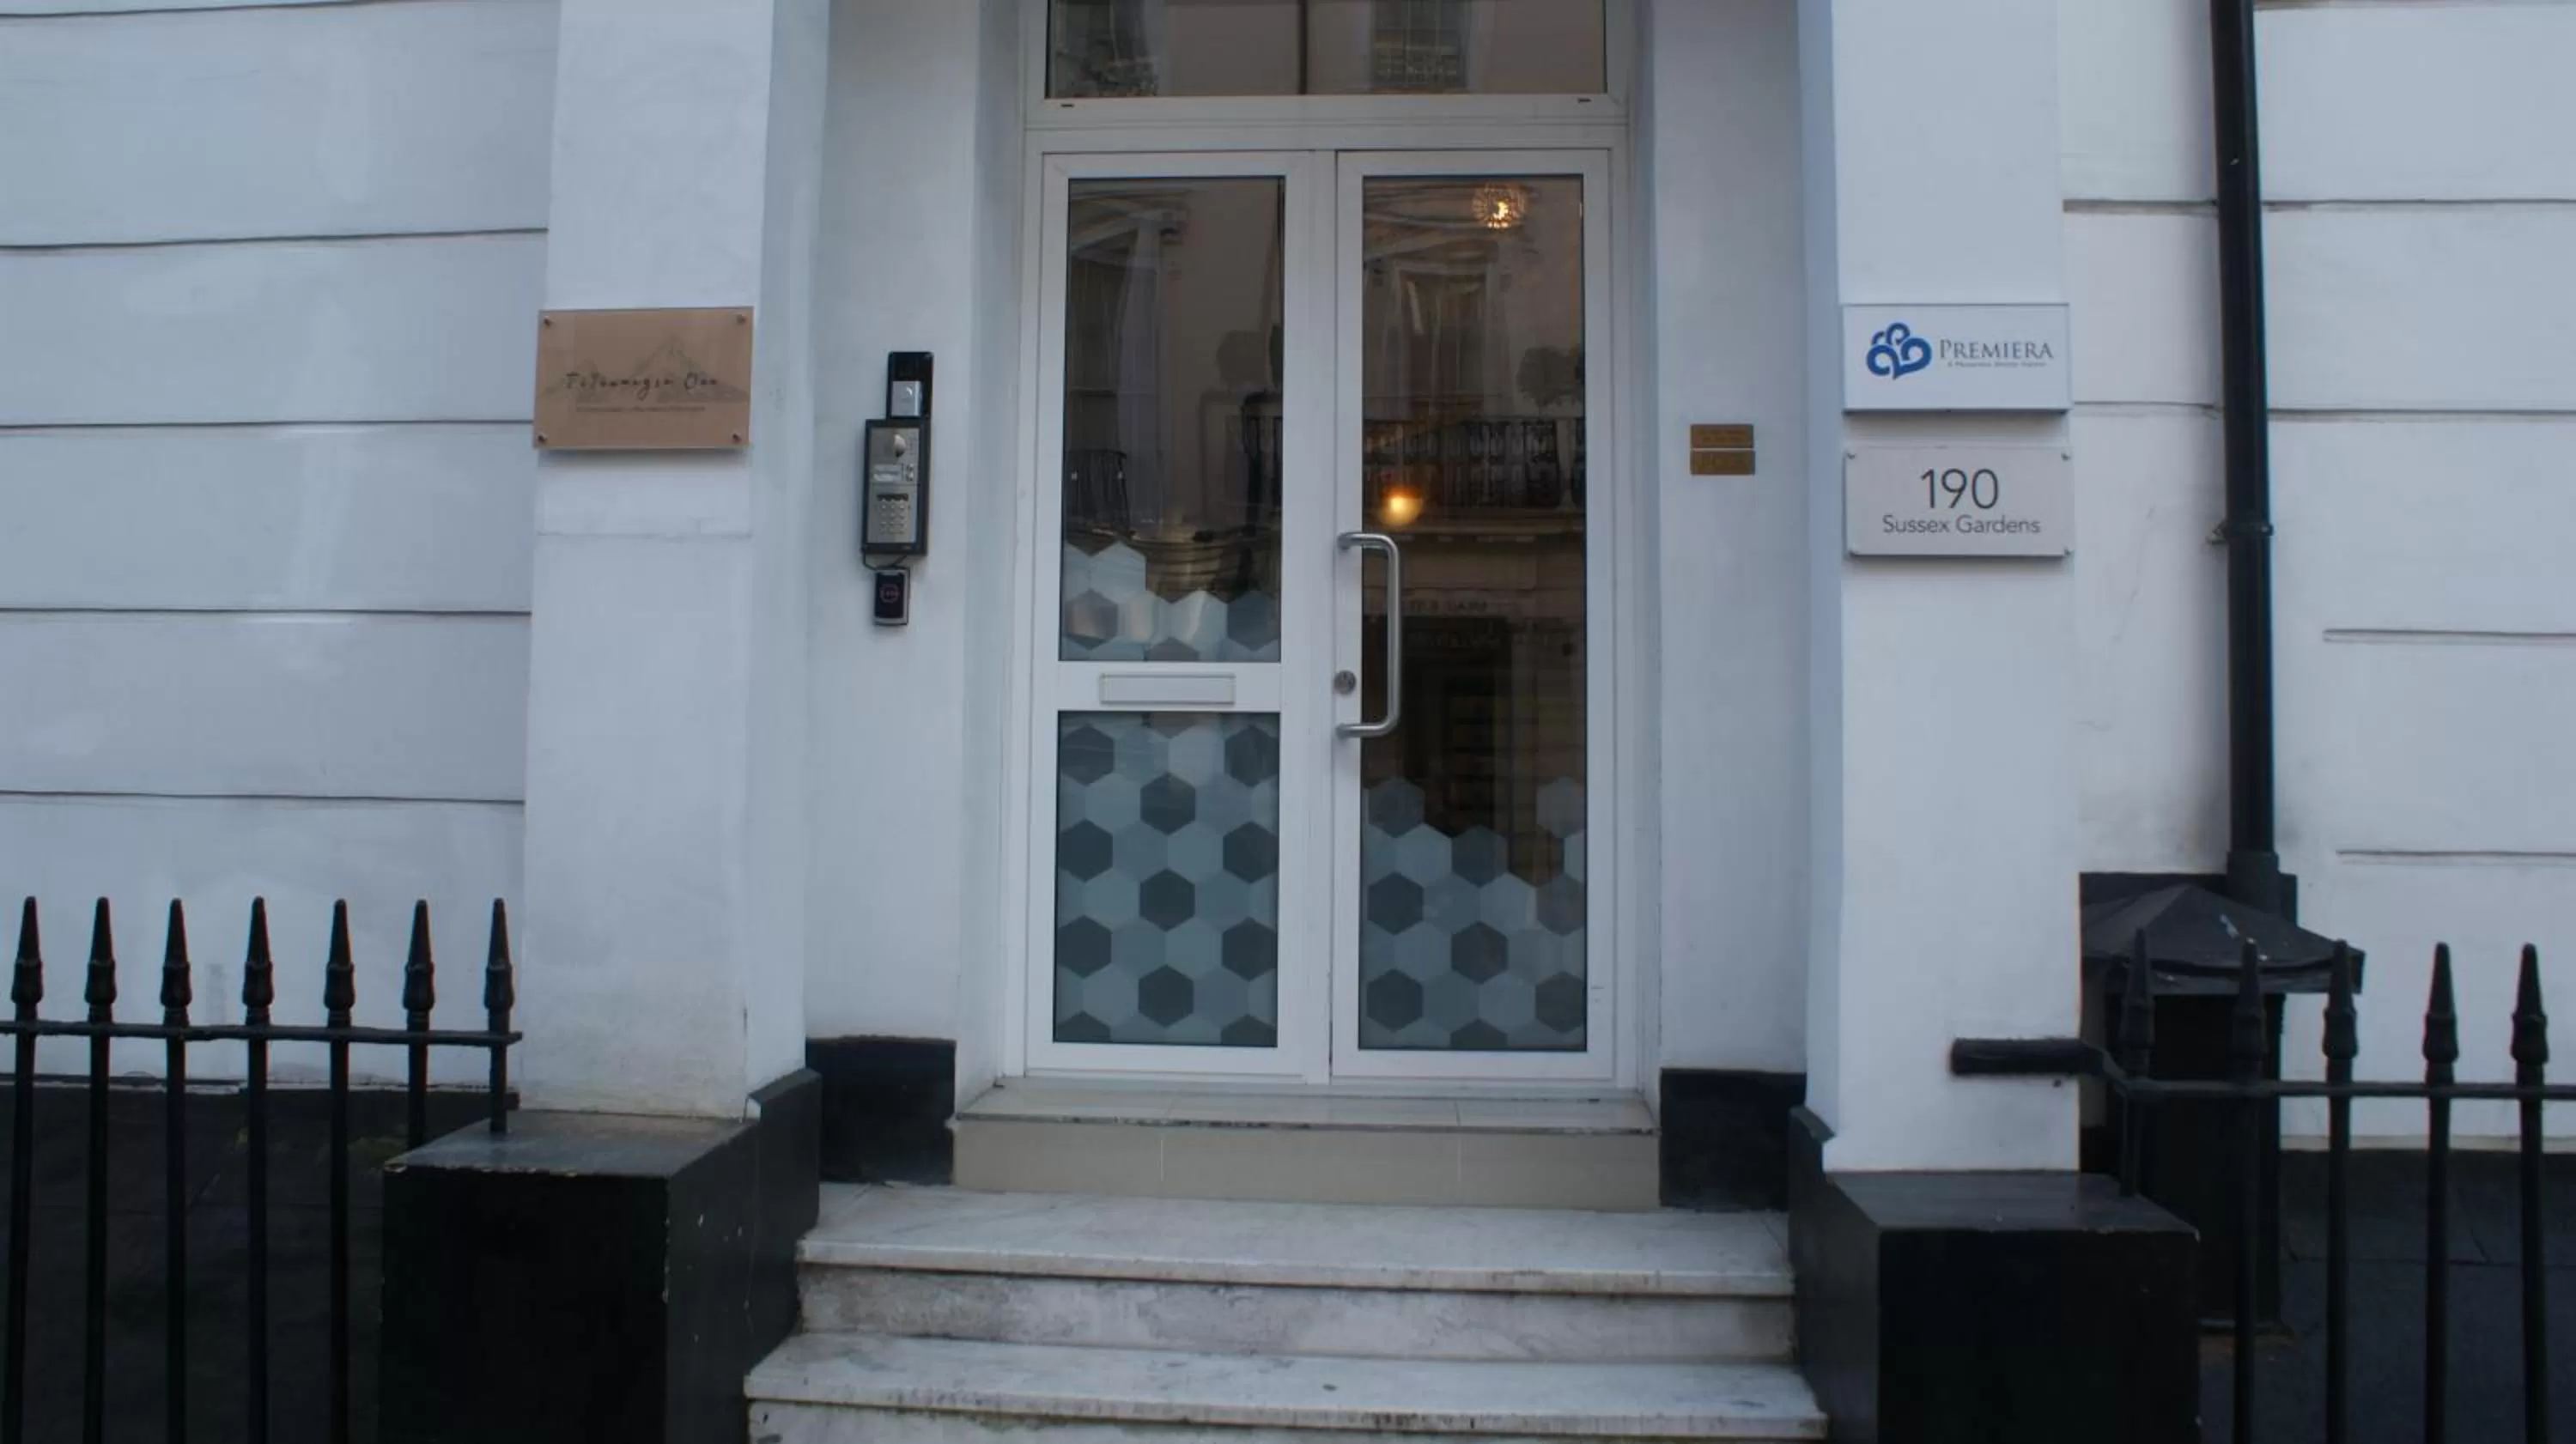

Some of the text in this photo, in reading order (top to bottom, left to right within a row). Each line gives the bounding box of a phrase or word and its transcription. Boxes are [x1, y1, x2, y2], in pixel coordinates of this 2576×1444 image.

[1939, 338, 2054, 360] PREMIERA
[1921, 468, 1999, 509] 190
[1882, 514, 2041, 534] Sussex Gardens
